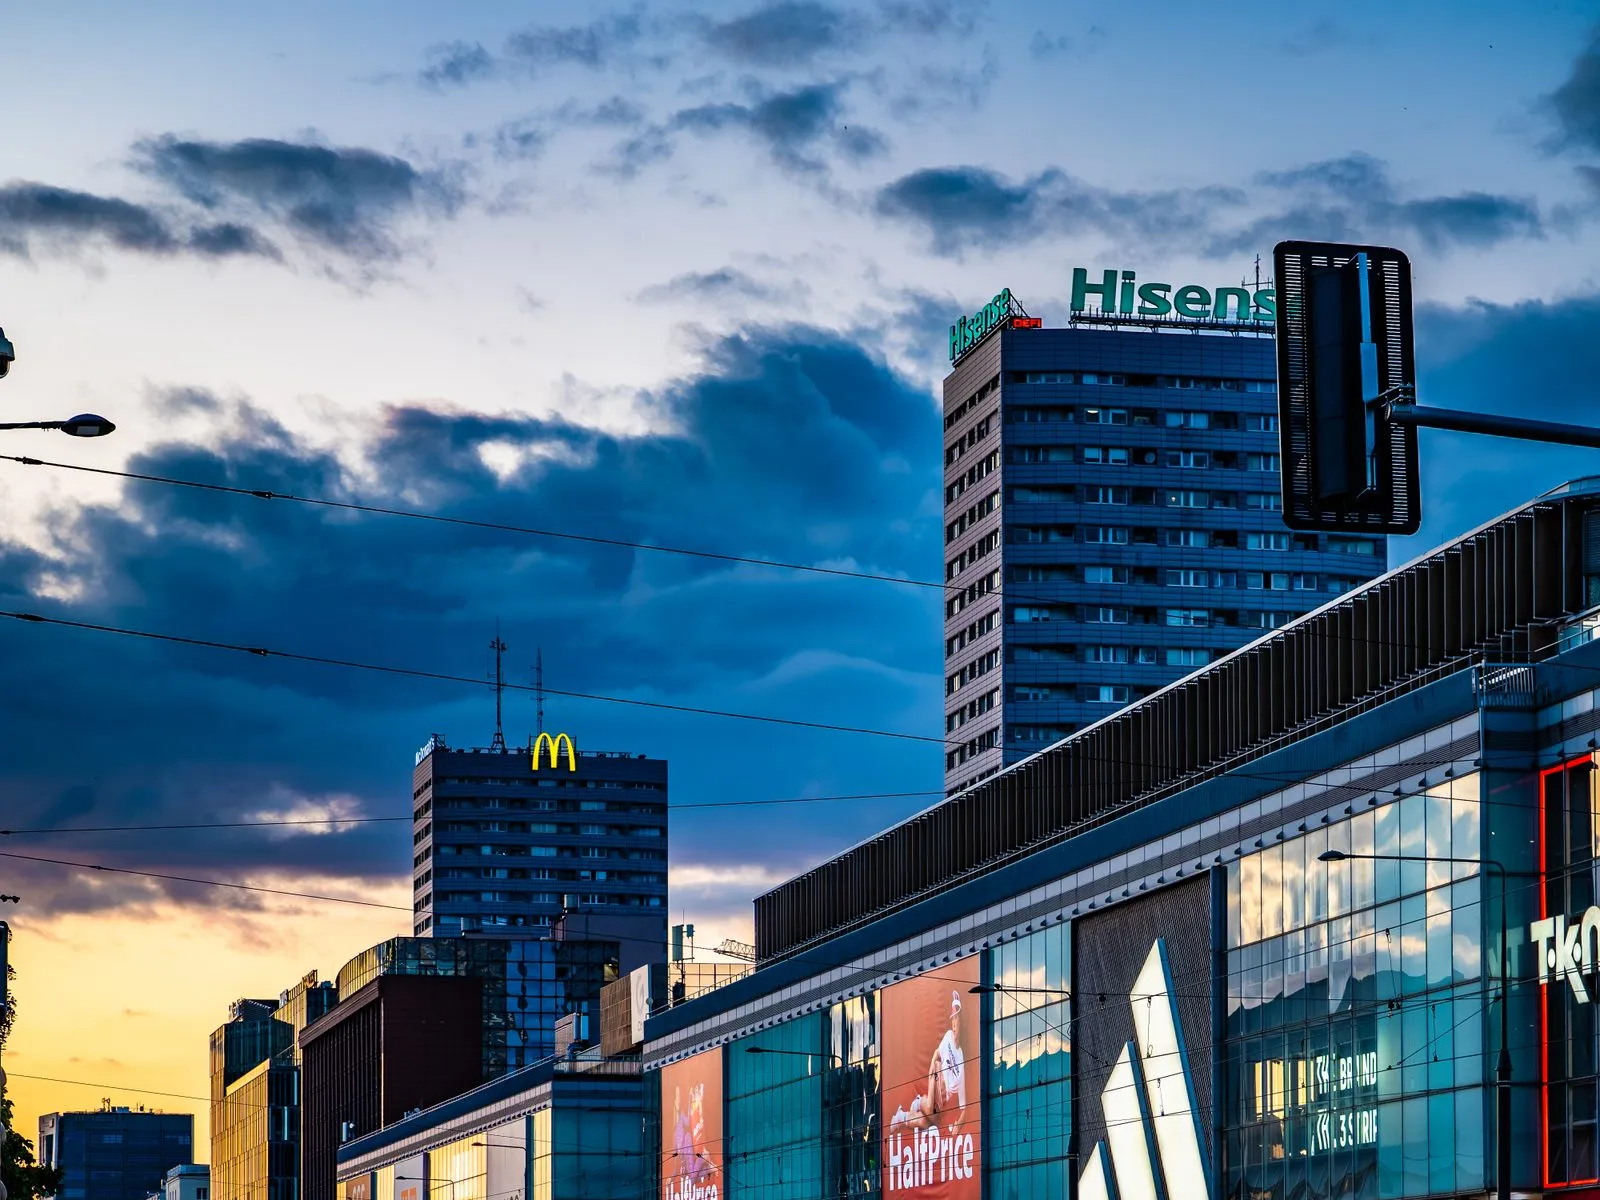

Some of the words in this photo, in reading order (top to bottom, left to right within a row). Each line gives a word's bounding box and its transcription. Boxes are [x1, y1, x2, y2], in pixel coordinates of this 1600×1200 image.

[949, 288, 1010, 361] Hisense
[1070, 267, 1275, 321] Hisens
[889, 1125, 974, 1191] HalfPrice
